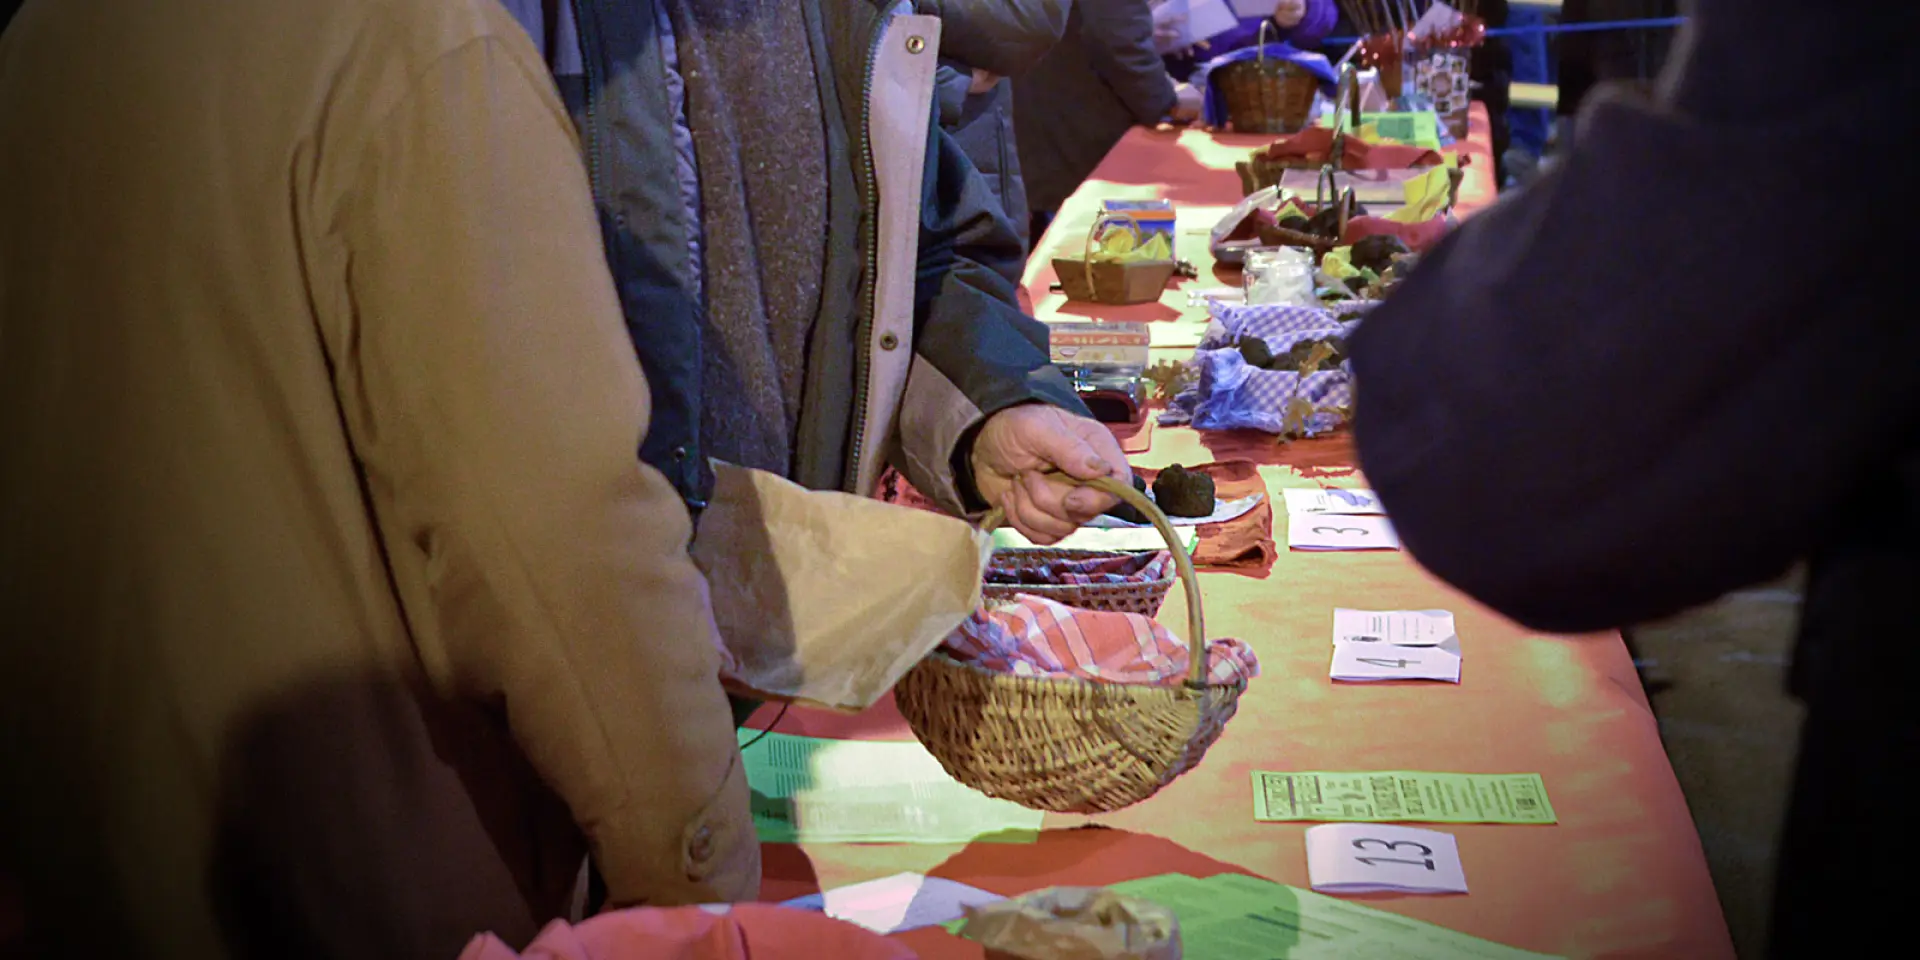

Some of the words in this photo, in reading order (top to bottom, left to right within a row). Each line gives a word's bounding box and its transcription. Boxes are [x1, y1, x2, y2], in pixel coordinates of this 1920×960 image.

[1312, 527, 1369, 536] 3
[1356, 658, 1422, 668] 4
[1352, 838, 1435, 871] 13
